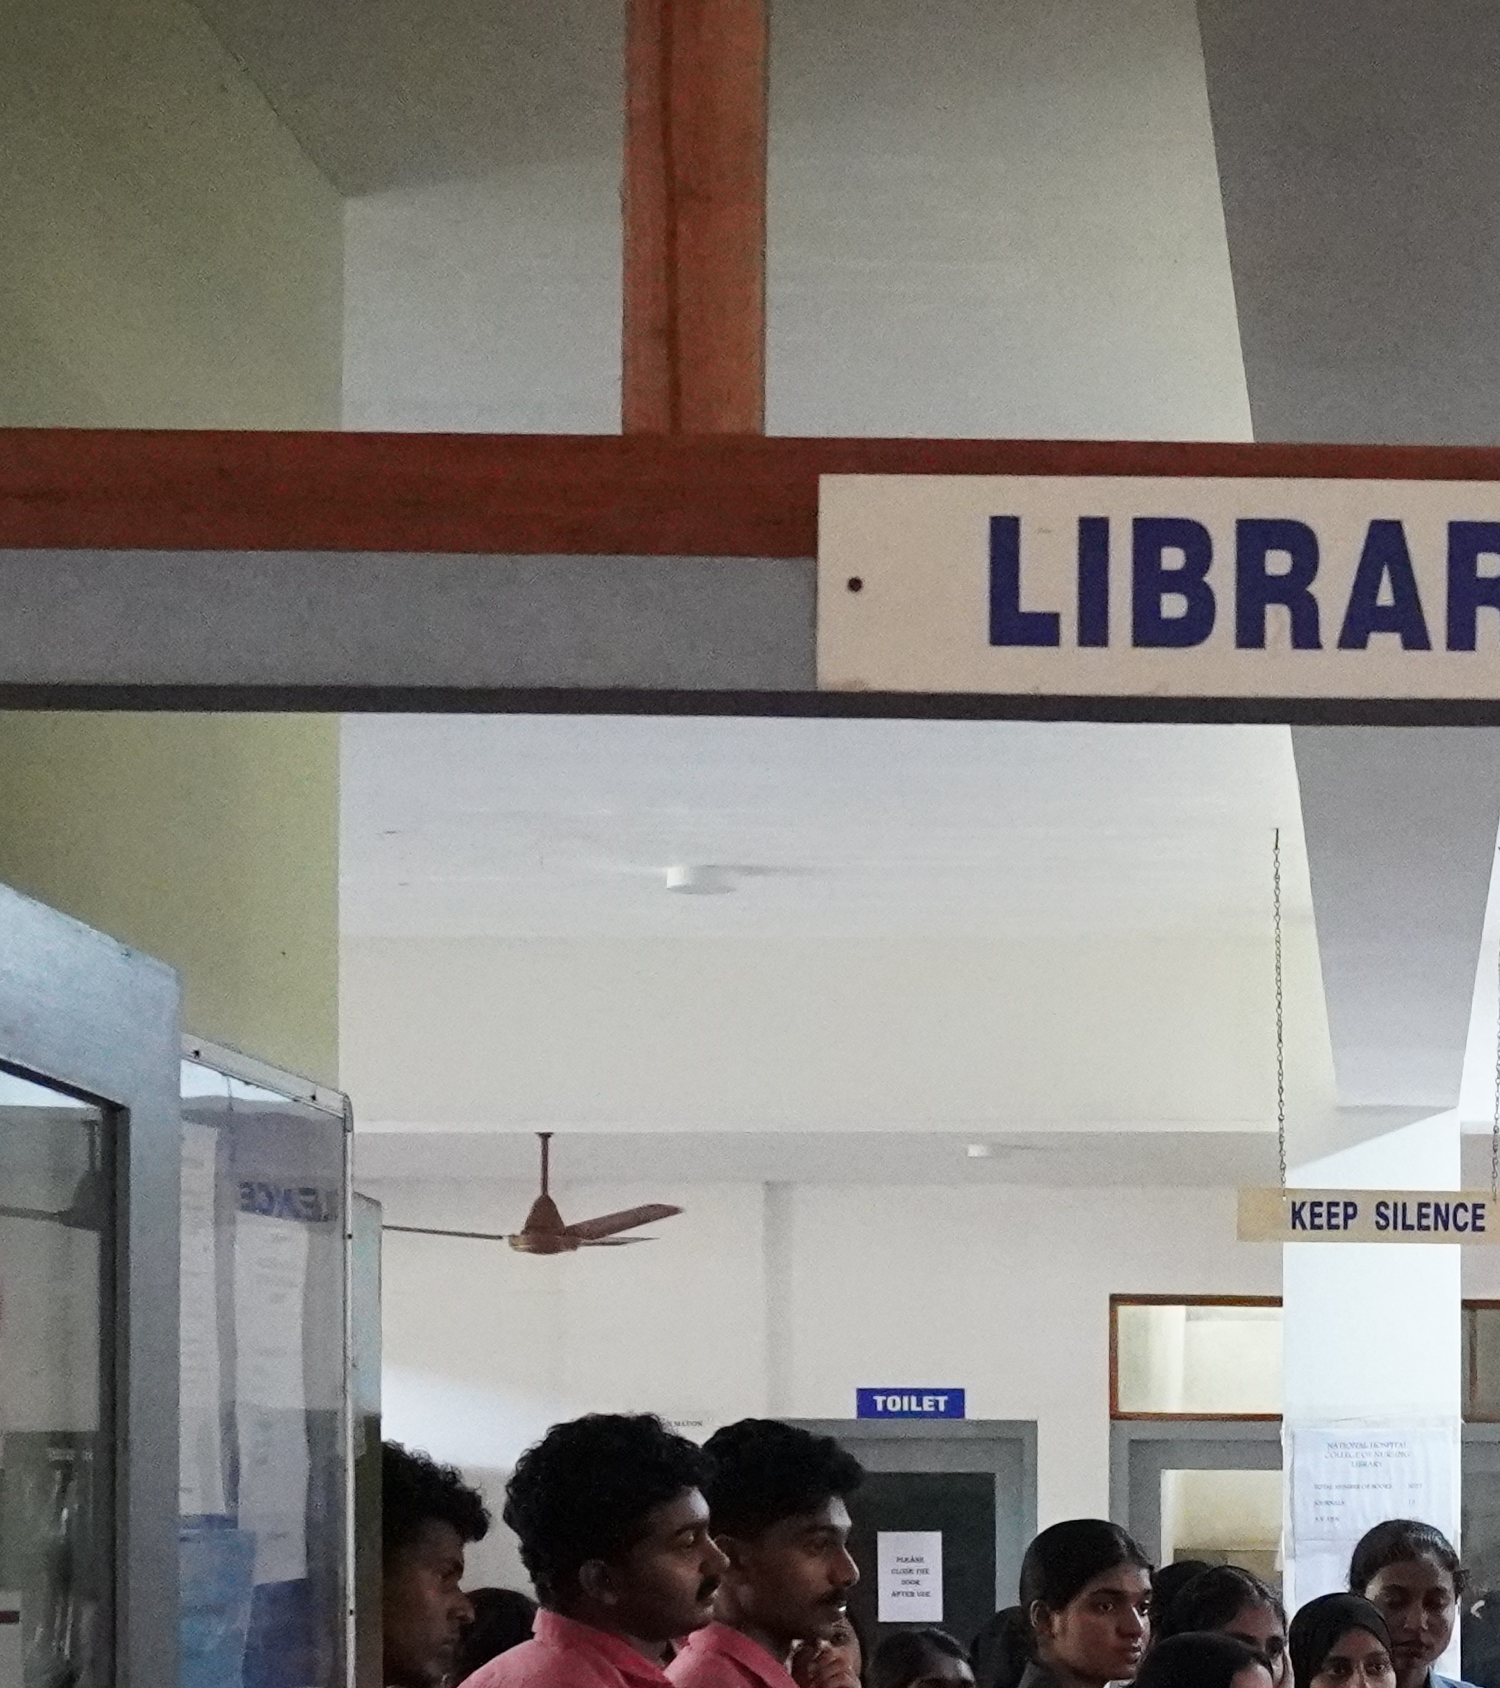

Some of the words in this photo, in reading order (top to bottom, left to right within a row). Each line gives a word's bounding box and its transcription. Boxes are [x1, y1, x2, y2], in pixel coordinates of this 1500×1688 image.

[1291, 1201, 1358, 1230] KEEP
[1375, 1202, 1486, 1232] SILENCE
[873, 1395, 948, 1412] TOILET
[896, 1555, 924, 1563] PLEASE
